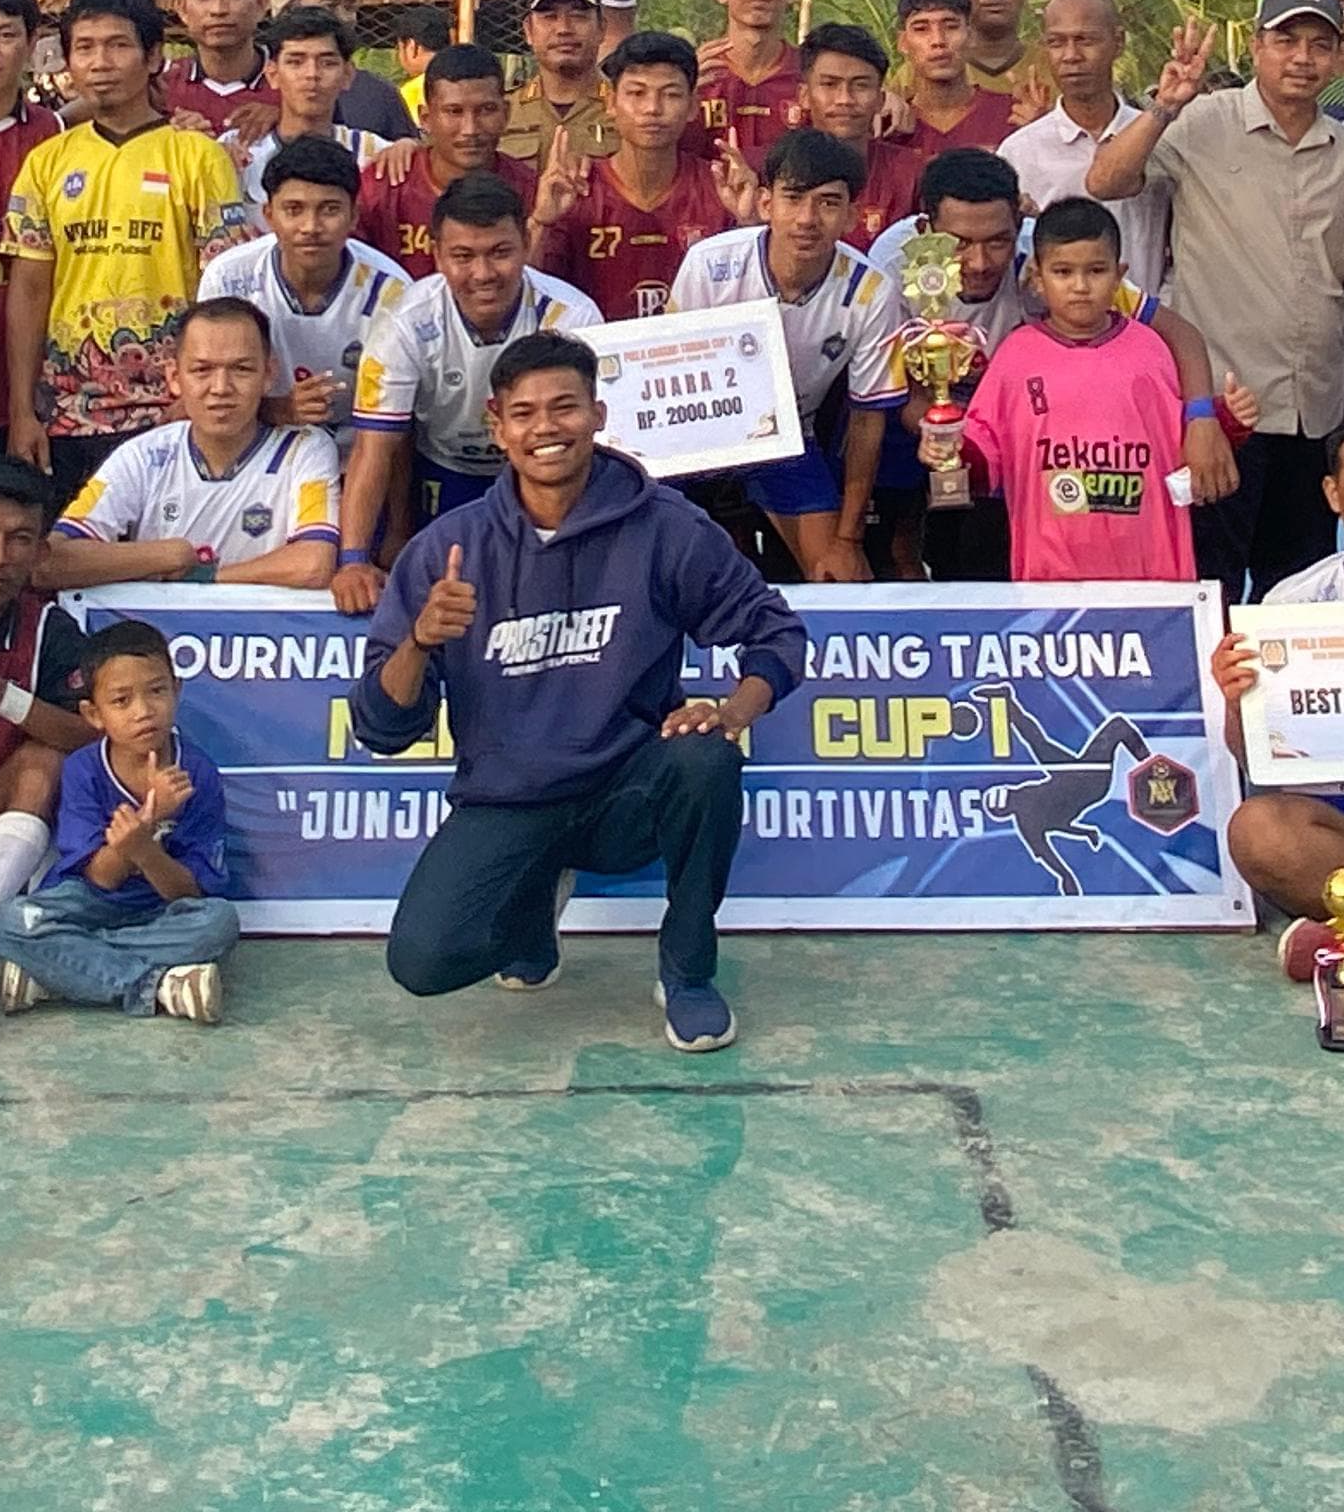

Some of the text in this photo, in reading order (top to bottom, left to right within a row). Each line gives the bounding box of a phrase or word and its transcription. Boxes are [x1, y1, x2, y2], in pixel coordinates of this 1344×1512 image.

[398, 223, 431, 255] 34
[588, 226, 622, 259] 27
[640, 367, 739, 402] JUARA 2
[1026, 376, 1049, 416] 8
[665, 396, 744, 426] 2000.000
[941, 632, 1152, 679] TARUNA
[1290, 688, 1342, 715] BEST
[812, 696, 954, 759] CUP
